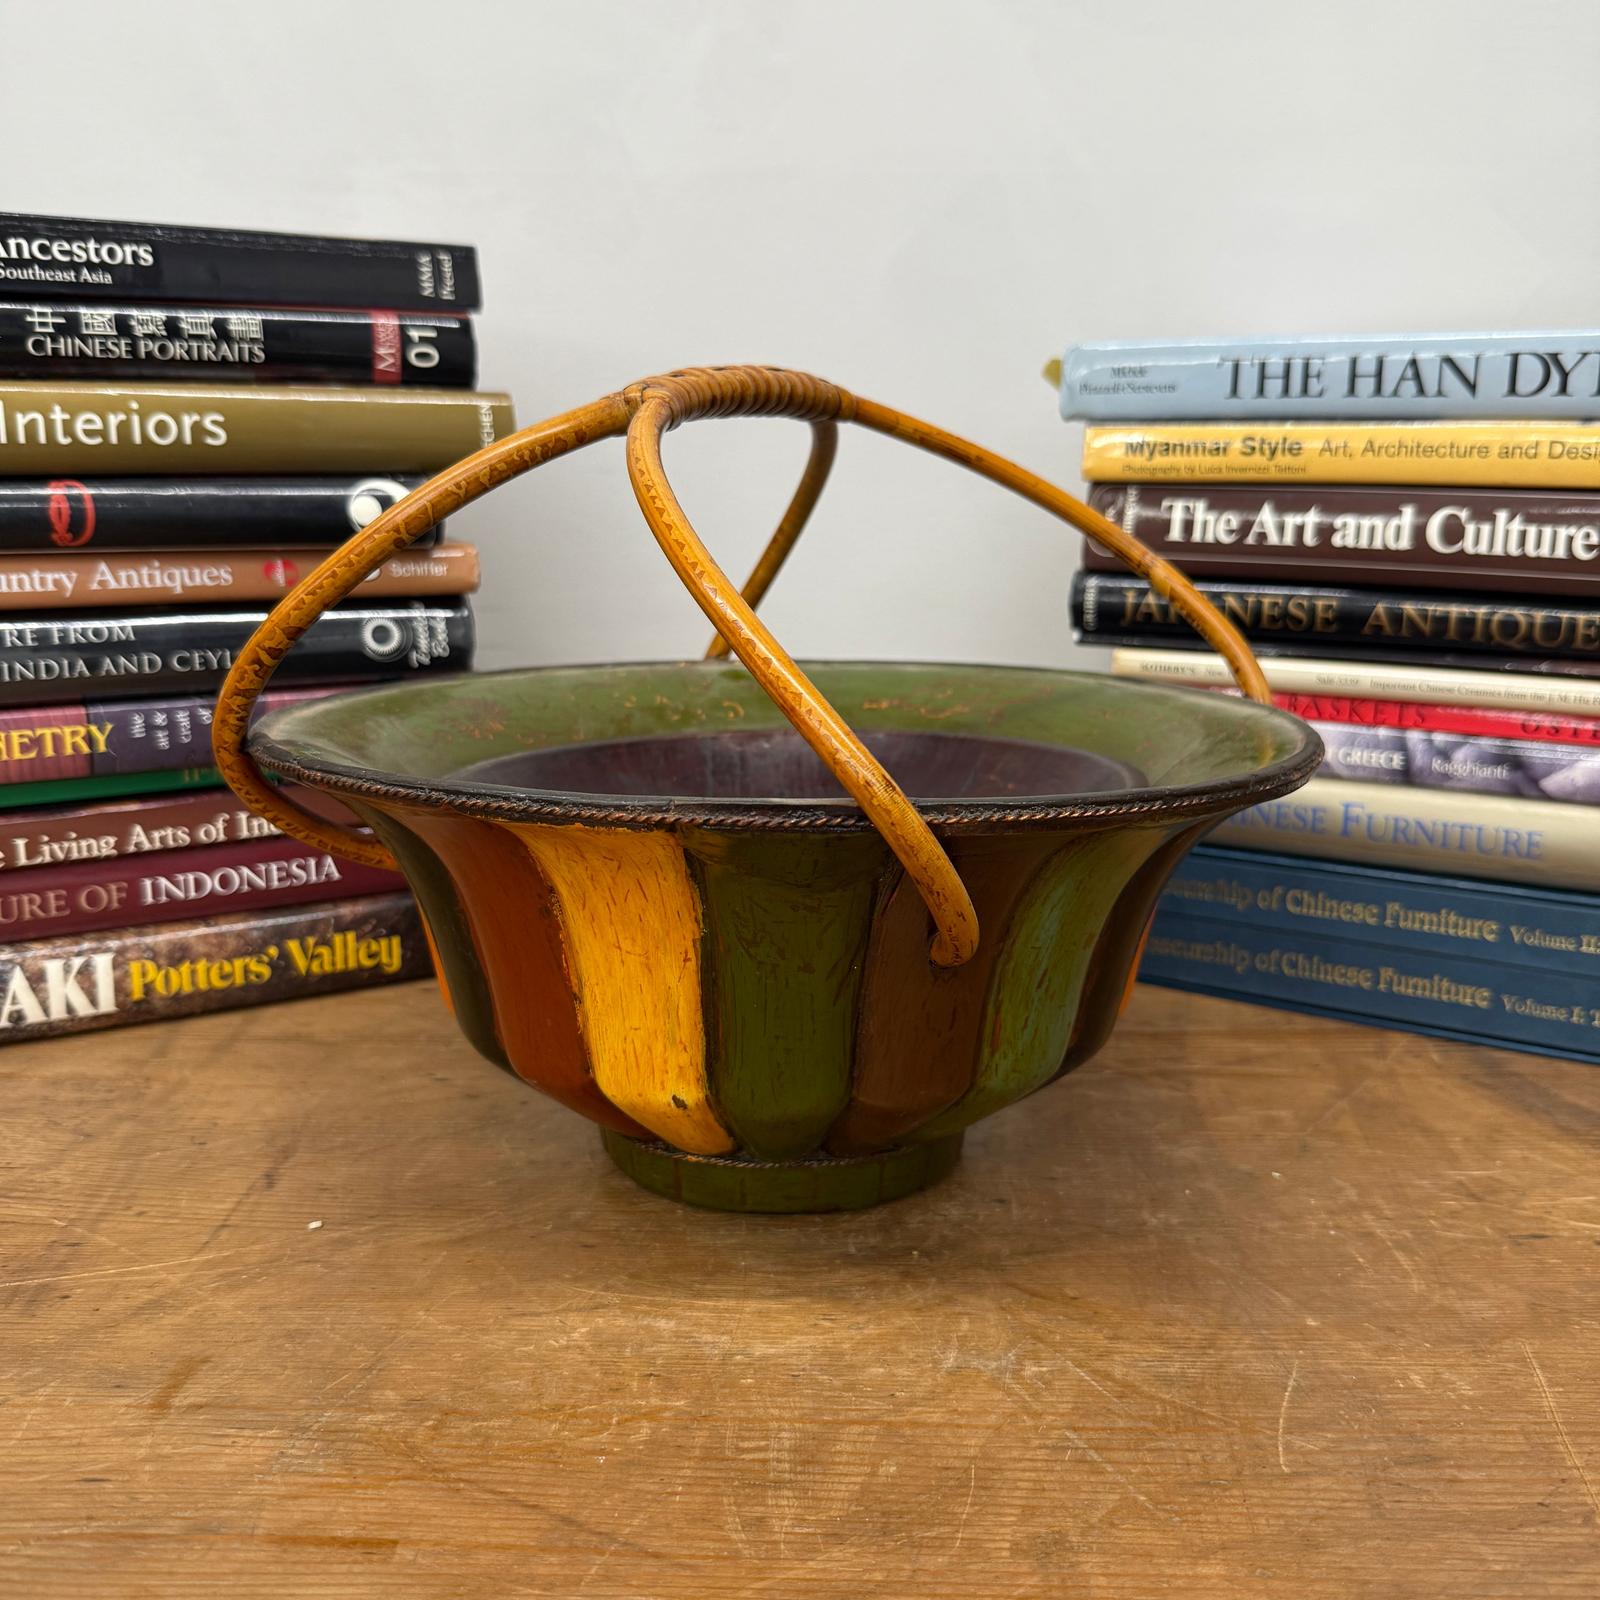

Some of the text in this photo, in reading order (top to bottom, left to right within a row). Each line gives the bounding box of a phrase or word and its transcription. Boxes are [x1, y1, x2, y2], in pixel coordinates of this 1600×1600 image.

[80, 265, 113, 285] Asia
[26, 334, 266, 364] CHINESE PORTRAITS
[1217, 350, 1600, 399] THE HAN DY
[0, 400, 228, 446] Interiors
[1125, 436, 1600, 464] Myanmar Style Art, Architecture and Desi
[1161, 497, 1241, 545] The
[1243, 500, 1322, 548] Art
[1331, 503, 1415, 551] and
[1425, 505, 1600, 561] Culture
[90, 559, 233, 594] Antiques
[49, 622, 137, 645] FROM
[1120, 588, 1340, 633] JANESE
[0, 656, 92, 682] INDIA
[98, 650, 163, 678] AND
[11, 831, 118, 867] Living
[126, 823, 192, 853] Arts
[196, 812, 230, 844] of
[1339, 801, 1545, 862] FURNITURE
[79, 881, 129, 913] OF
[139, 854, 343, 906] INDONESIA
[1257, 885, 1286, 910] of
[1285, 888, 1380, 926] Chinese
[1384, 901, 1500, 943] Furniture
[1509, 925, 1577, 952] Volume
[285, 930, 402, 977] Valley
[1254, 948, 1280, 973] of
[1281, 951, 1374, 991] Chinese
[1377, 965, 1492, 1010] Furniture
[1500, 993, 1569, 1022] Volume
